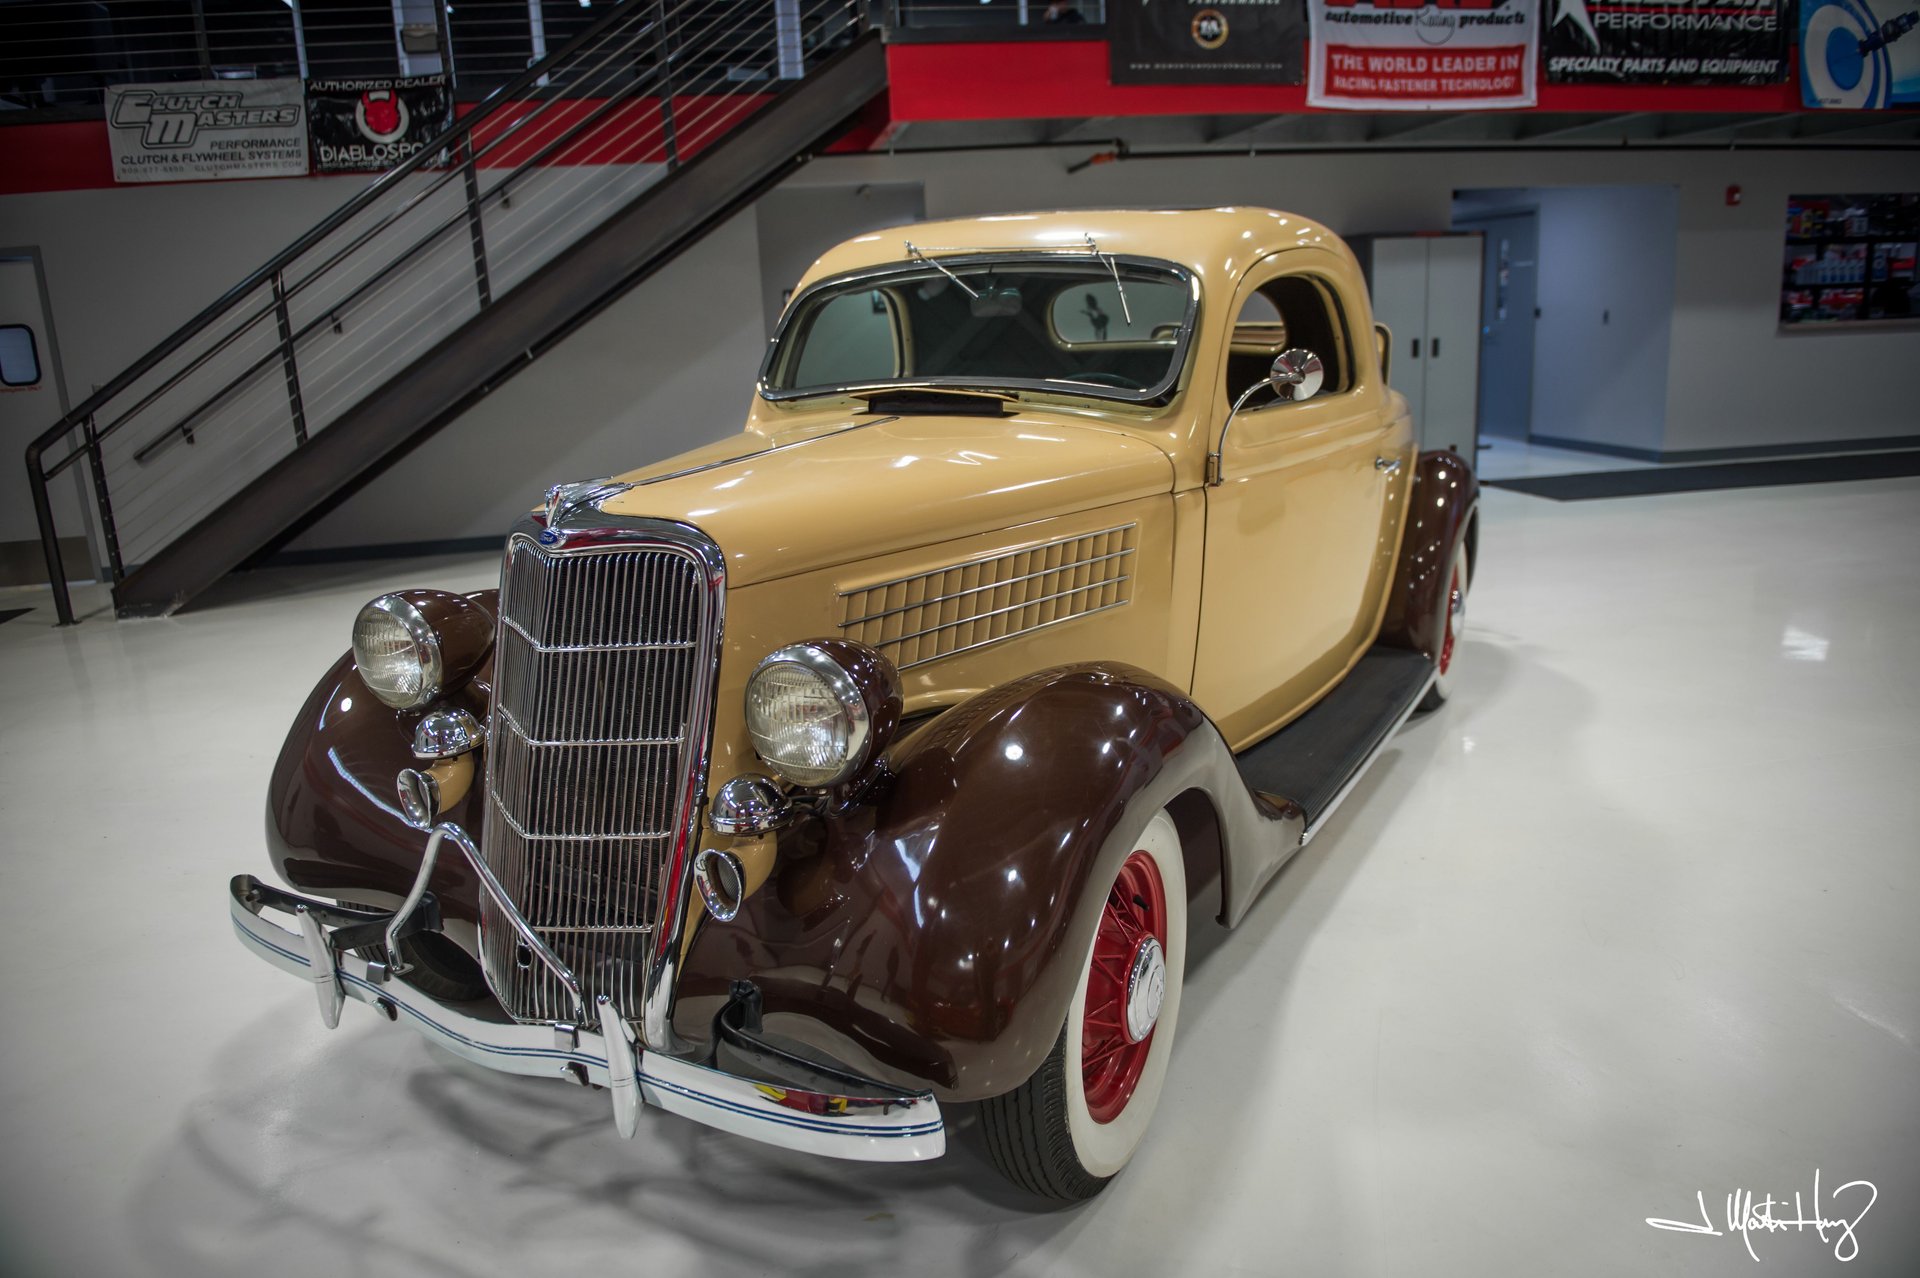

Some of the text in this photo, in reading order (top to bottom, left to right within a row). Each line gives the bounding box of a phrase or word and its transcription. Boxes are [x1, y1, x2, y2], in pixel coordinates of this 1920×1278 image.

[1325, 11, 1412, 25] automotive
[1459, 11, 1525, 27] products
[1594, 12, 1778, 32] PERFORMANCE
[1331, 53, 1520, 73] THE WORLD LEADER IN
[1549, 56, 1780, 75] SPECIALTY PARTS AND EQUIPMENT
[308, 74, 447, 92] AUTHORIZED DEALER
[1378, 75, 1438, 91] FASTENER
[112, 90, 242, 128] CLUTCH
[142, 105, 300, 148] MASTERS
[210, 138, 301, 150] PERFORMANCE
[121, 149, 302, 165] CLUTCH & FLYWHEEL SYSTEMS
